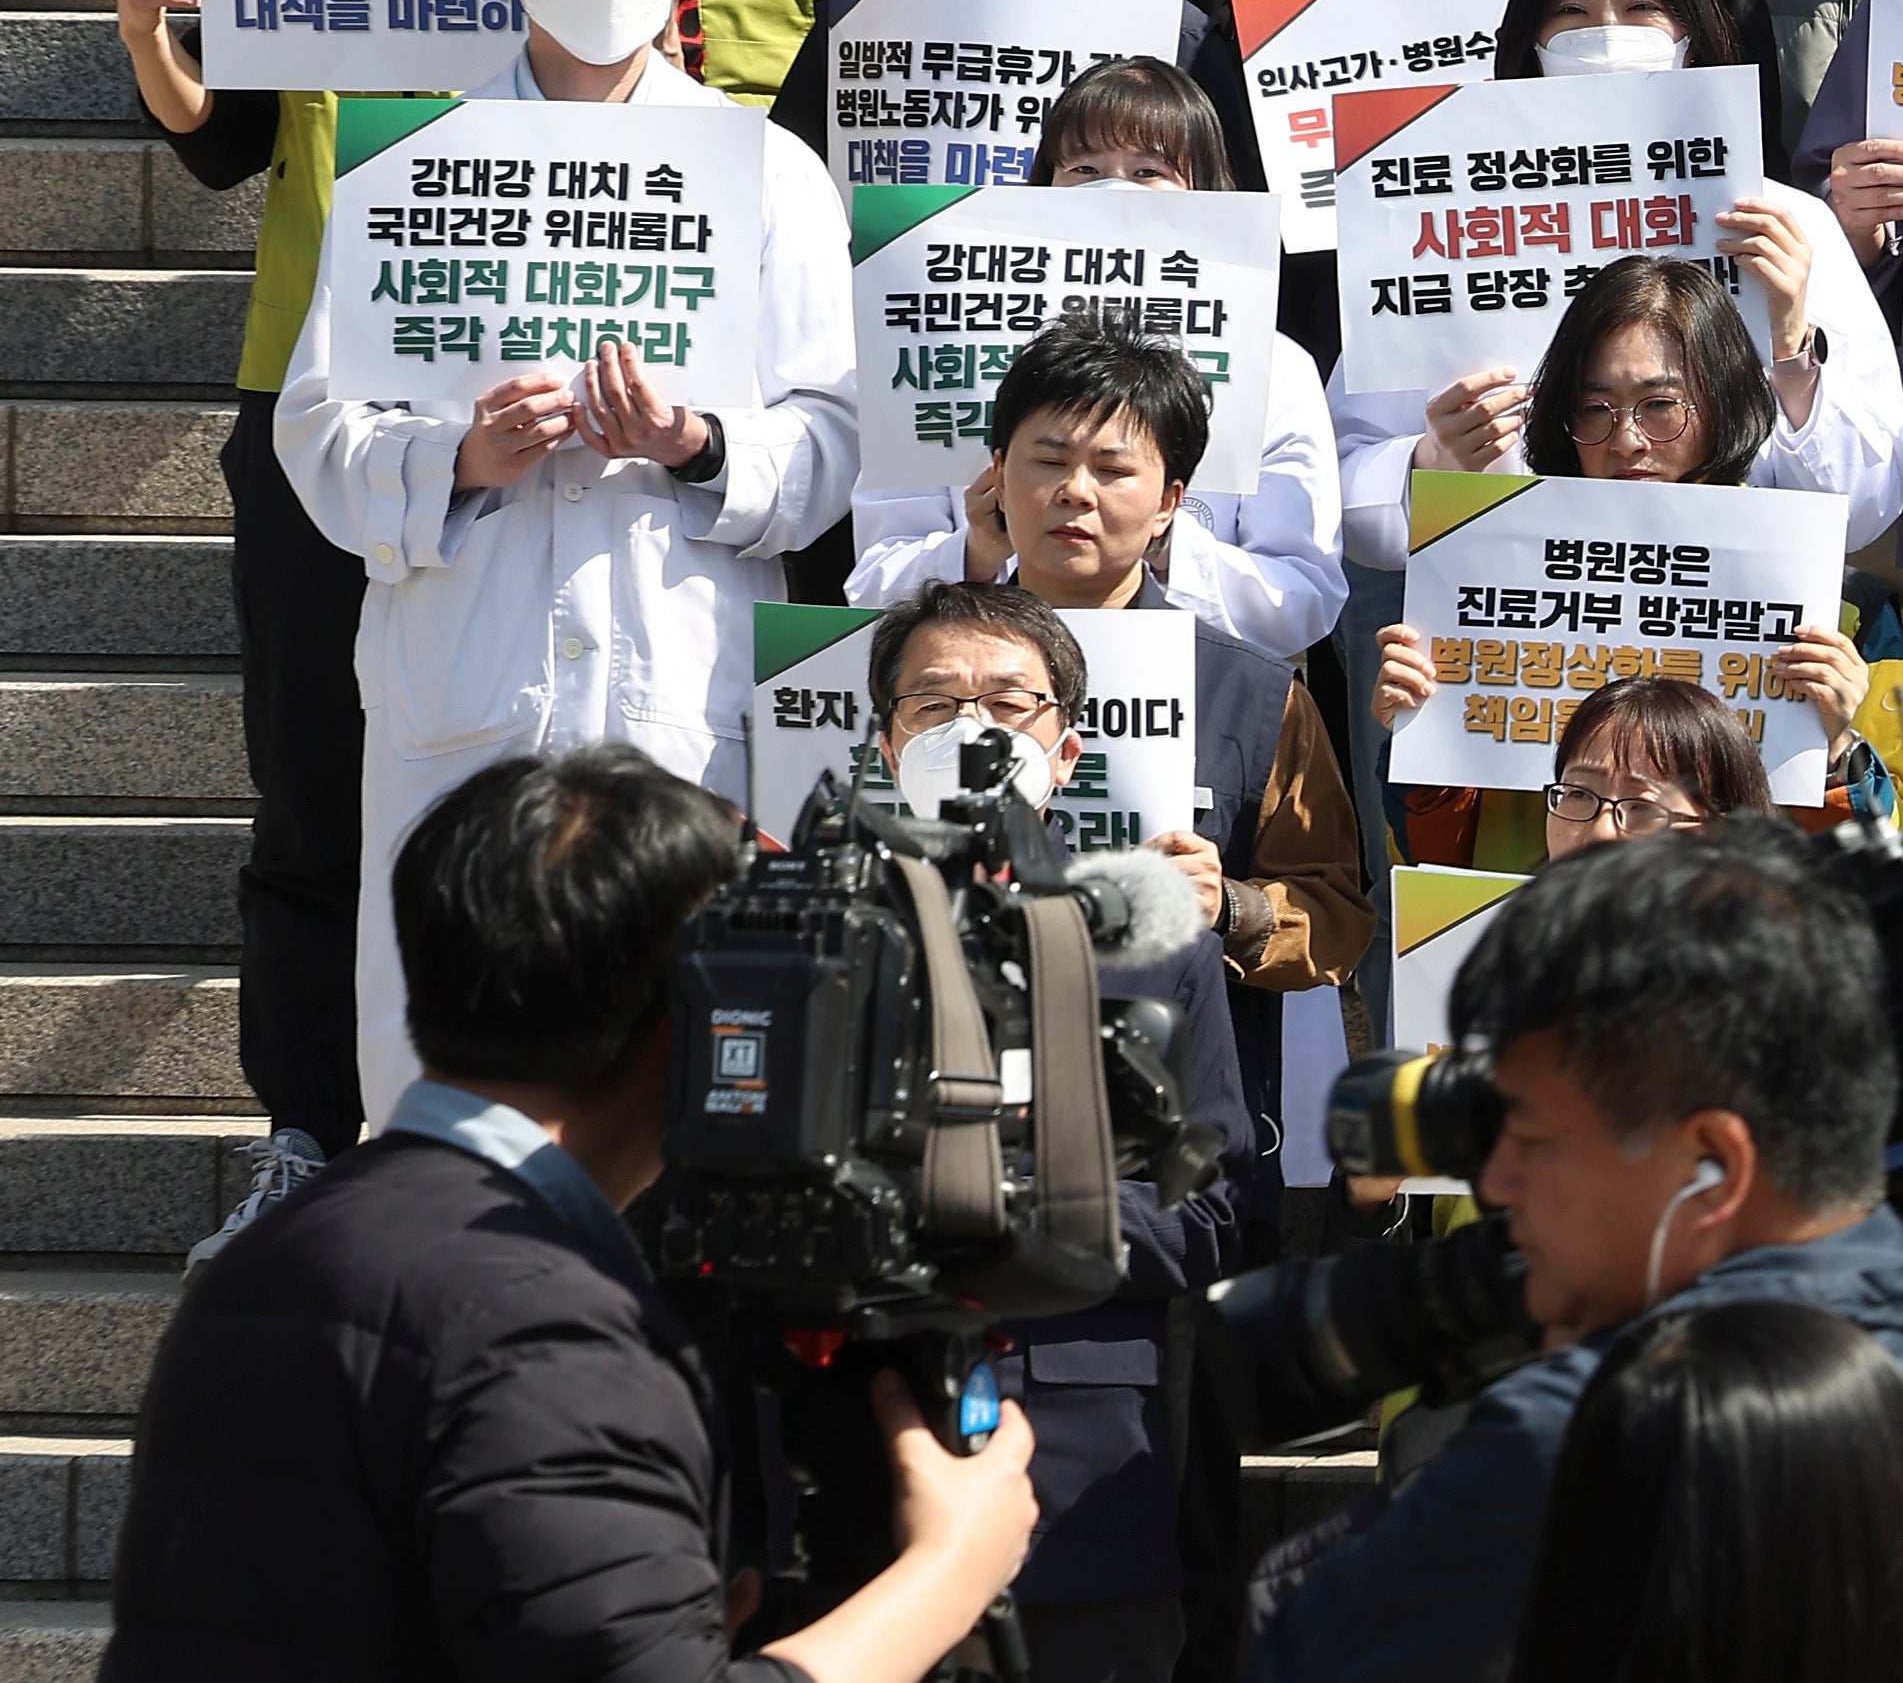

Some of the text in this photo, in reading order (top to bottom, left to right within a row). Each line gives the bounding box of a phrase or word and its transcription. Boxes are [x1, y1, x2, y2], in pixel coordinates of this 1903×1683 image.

[411, 158, 684, 204] 강대강 대치 속
[1467, 136, 1728, 192] 정상화를 위한
[367, 207, 713, 254] 국민건강 위태롭다
[1412, 193, 1701, 260] 사회적 대화
[371, 258, 716, 312] 사회적 대화기구
